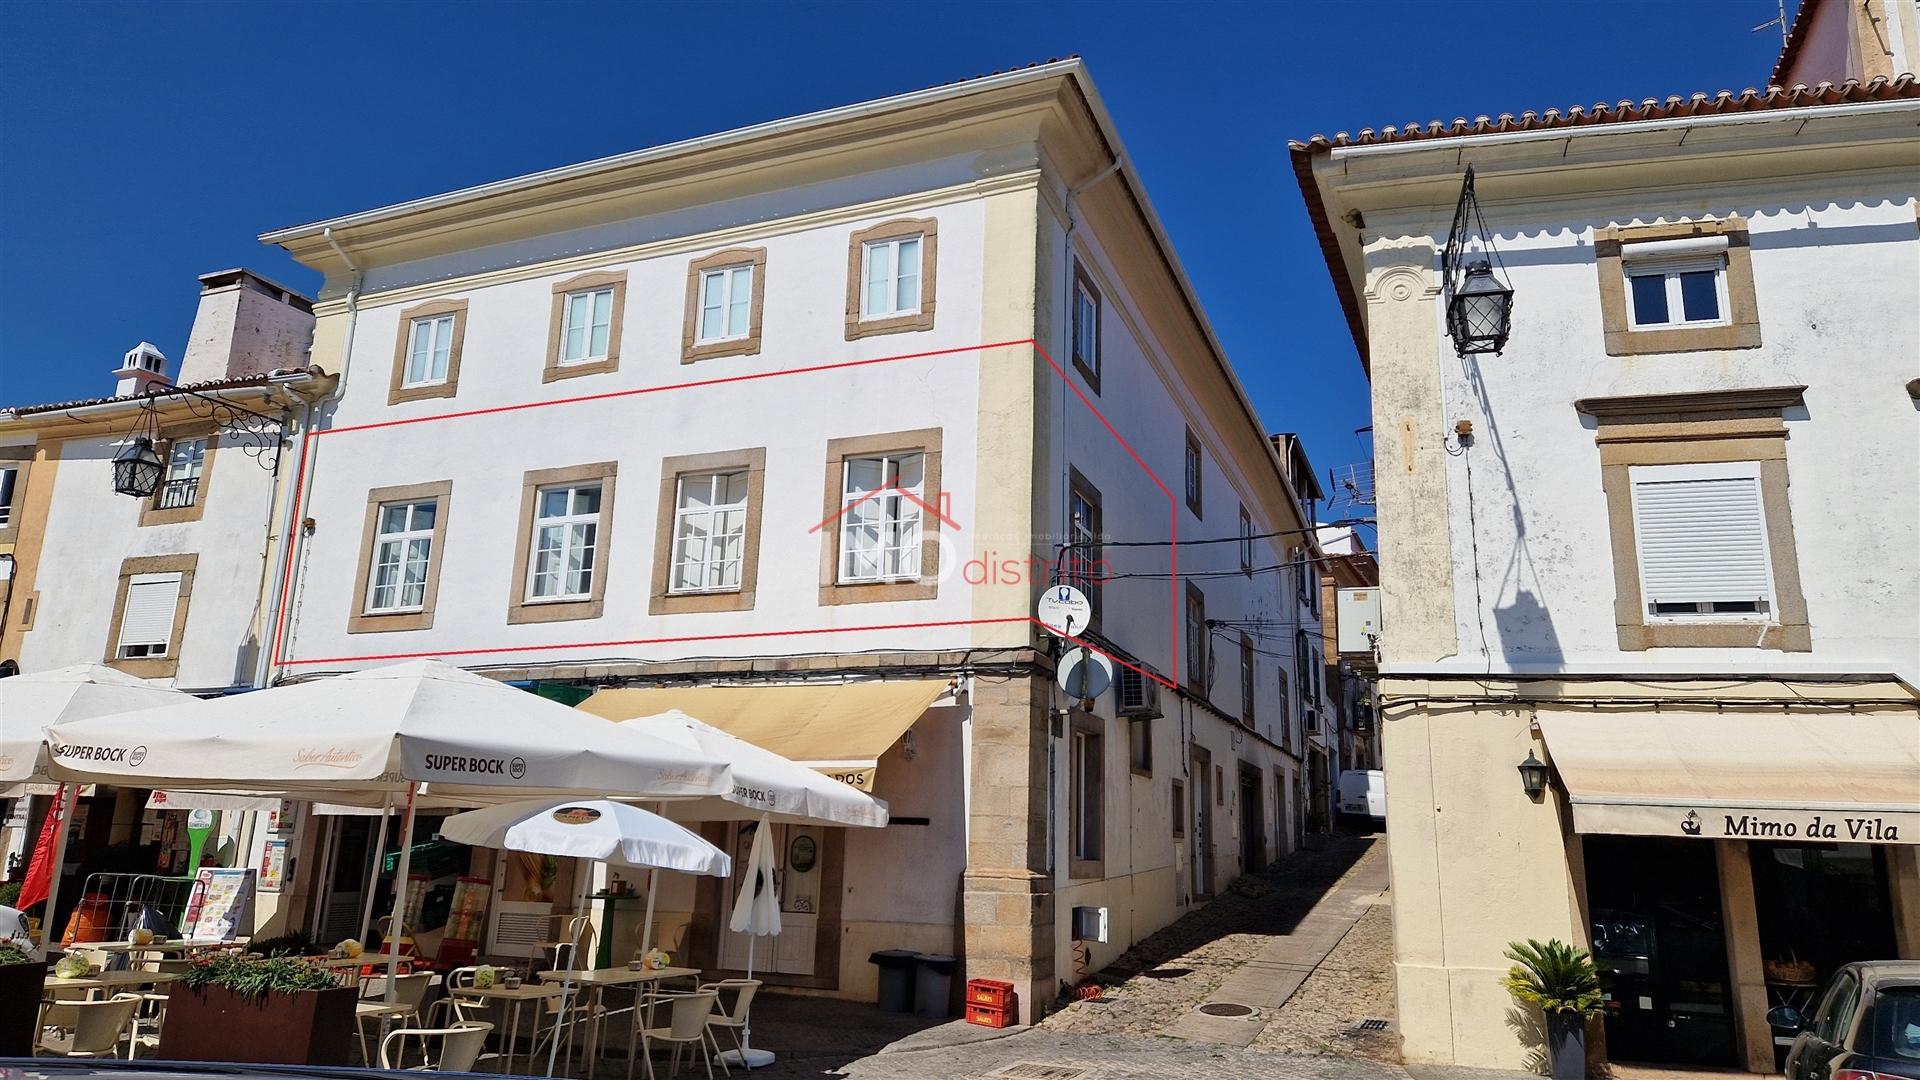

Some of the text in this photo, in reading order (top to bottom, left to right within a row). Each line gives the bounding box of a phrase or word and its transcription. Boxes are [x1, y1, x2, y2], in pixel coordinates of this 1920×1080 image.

[54, 744, 127, 762] SUPER BOCK
[425, 754, 504, 774] SUPER BOCK
[748, 788, 766, 802] BOCK
[1724, 815, 1899, 840] Mimo da Vila
